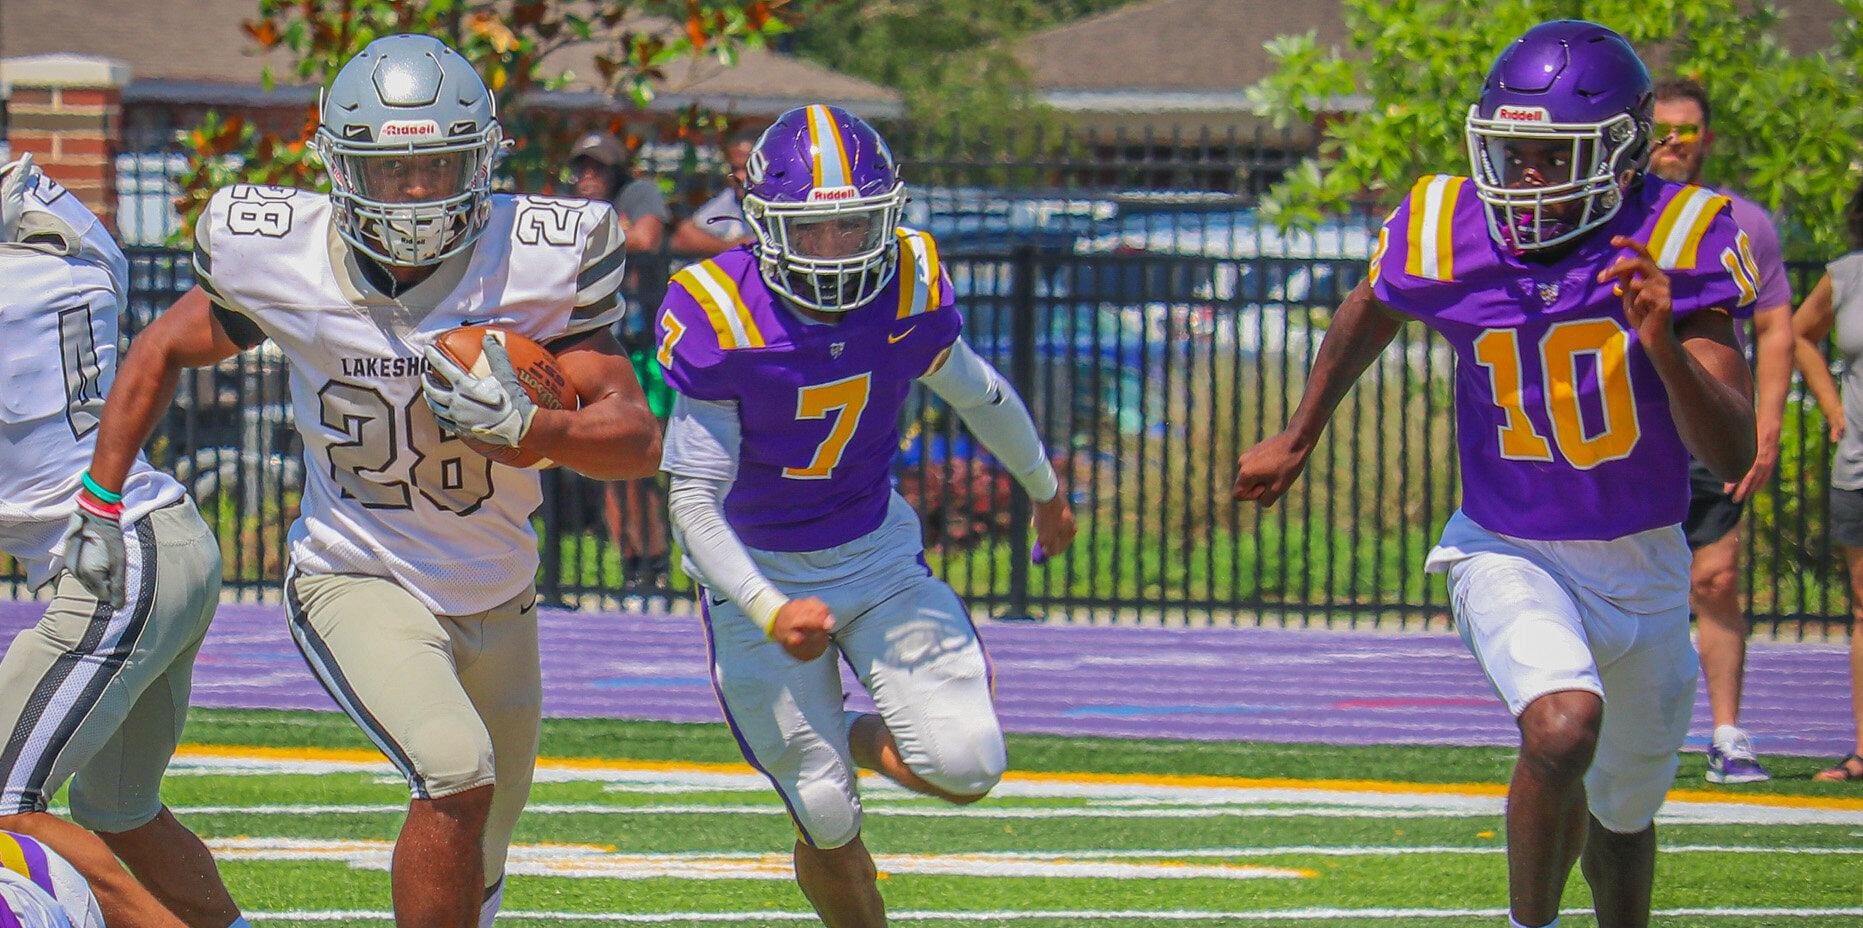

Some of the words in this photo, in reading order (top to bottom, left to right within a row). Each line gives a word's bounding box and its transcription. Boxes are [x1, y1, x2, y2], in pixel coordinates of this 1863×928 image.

[386, 123, 435, 135] Riddell
[1501, 108, 1543, 121] Riddell
[814, 188, 855, 200] Riddell
[400, 237, 427, 246] Ridell
[656, 308, 687, 371] 7
[1472, 316, 1642, 472] 10
[781, 370, 873, 481] 7
[317, 378, 495, 518] 28
